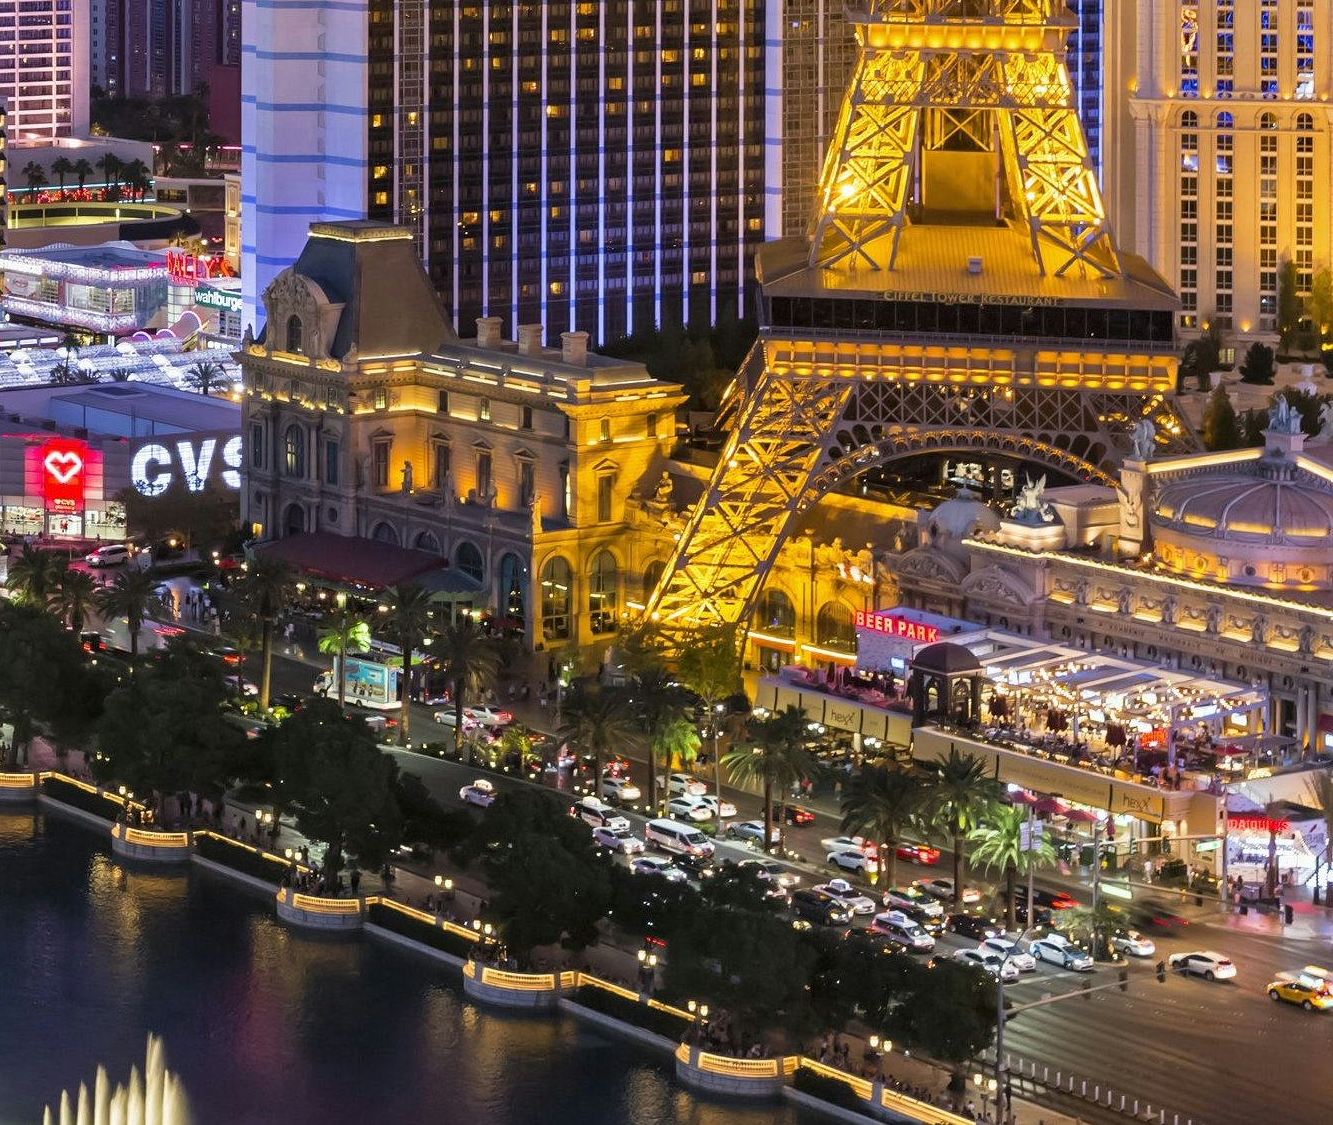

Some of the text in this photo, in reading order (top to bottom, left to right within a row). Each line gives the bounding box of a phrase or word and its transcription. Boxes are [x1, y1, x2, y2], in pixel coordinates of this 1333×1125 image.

[165, 250, 231, 281] BALLY'S
[131, 436, 243, 497] CVS
[856, 611, 938, 642] BEER PARK
